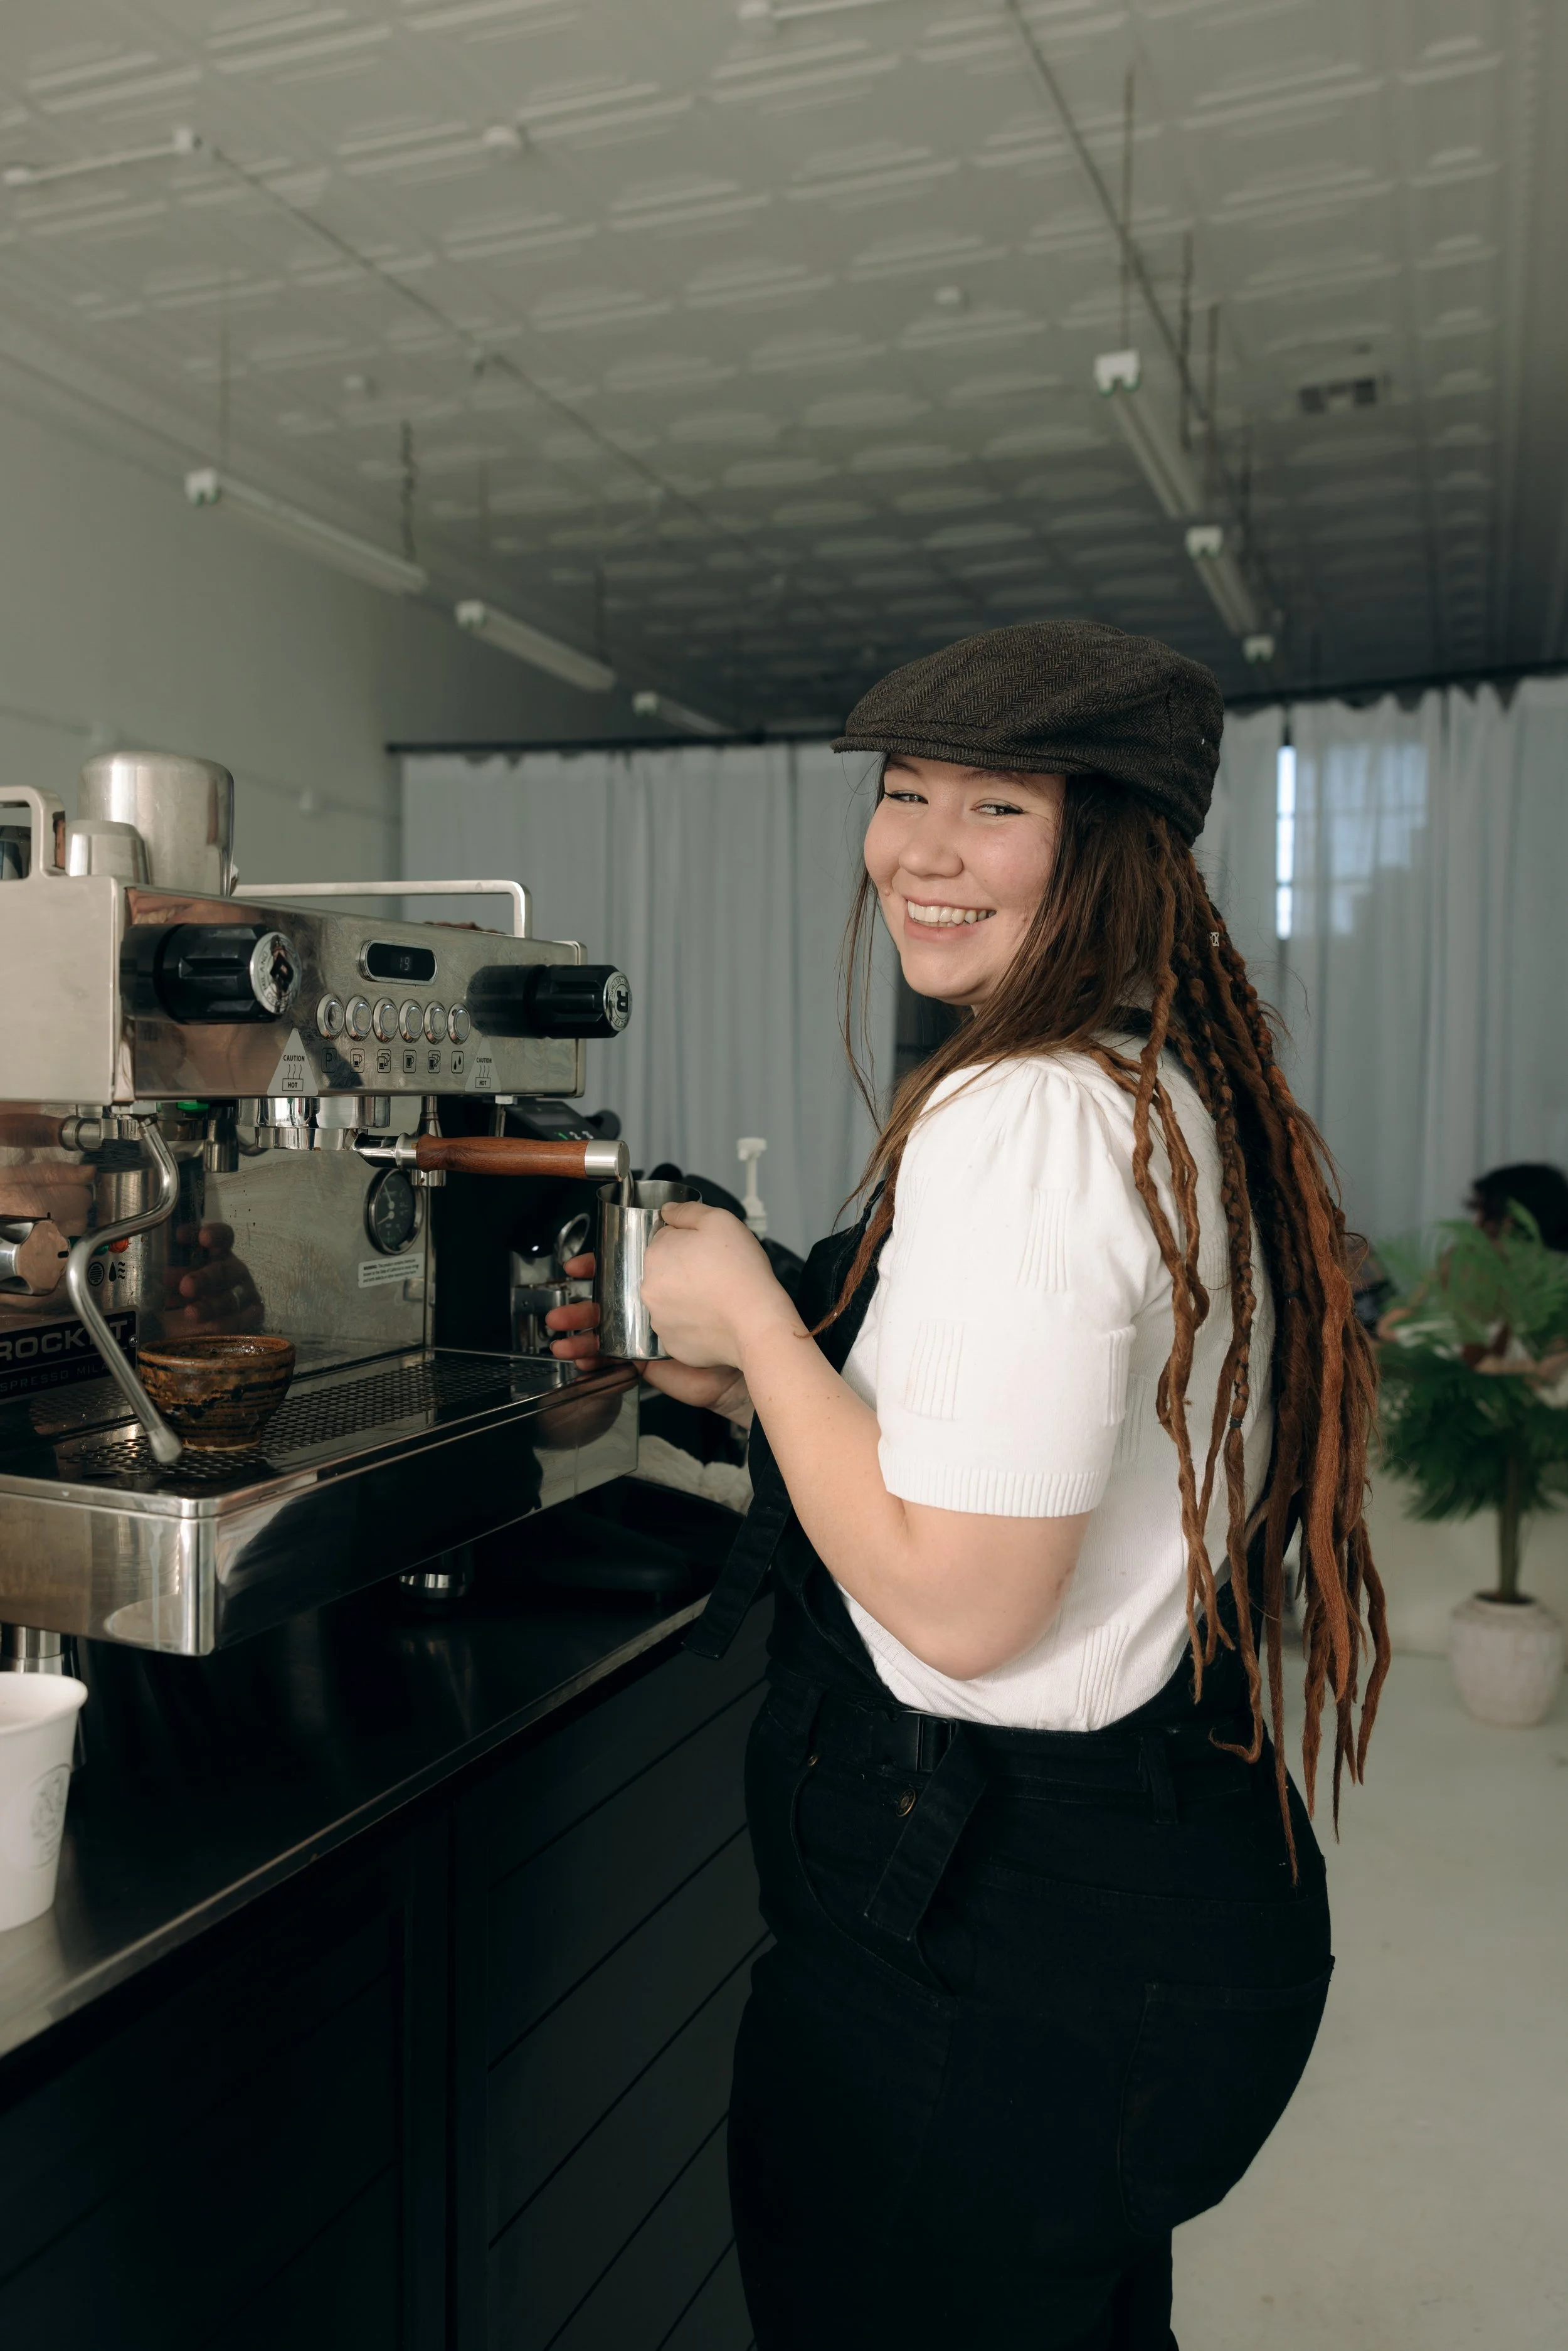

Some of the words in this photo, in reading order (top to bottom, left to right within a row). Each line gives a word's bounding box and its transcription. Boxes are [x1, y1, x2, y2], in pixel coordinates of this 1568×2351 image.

[259, 950, 268, 990] MILANO
[617, 990, 628, 1012] R
[326, 1053, 333, 1068] P
[0, 1320, 127, 1361] ROCKT
[0, 1370, 69, 1393] SPRESSO
[77, 1362, 110, 1377] MILA
